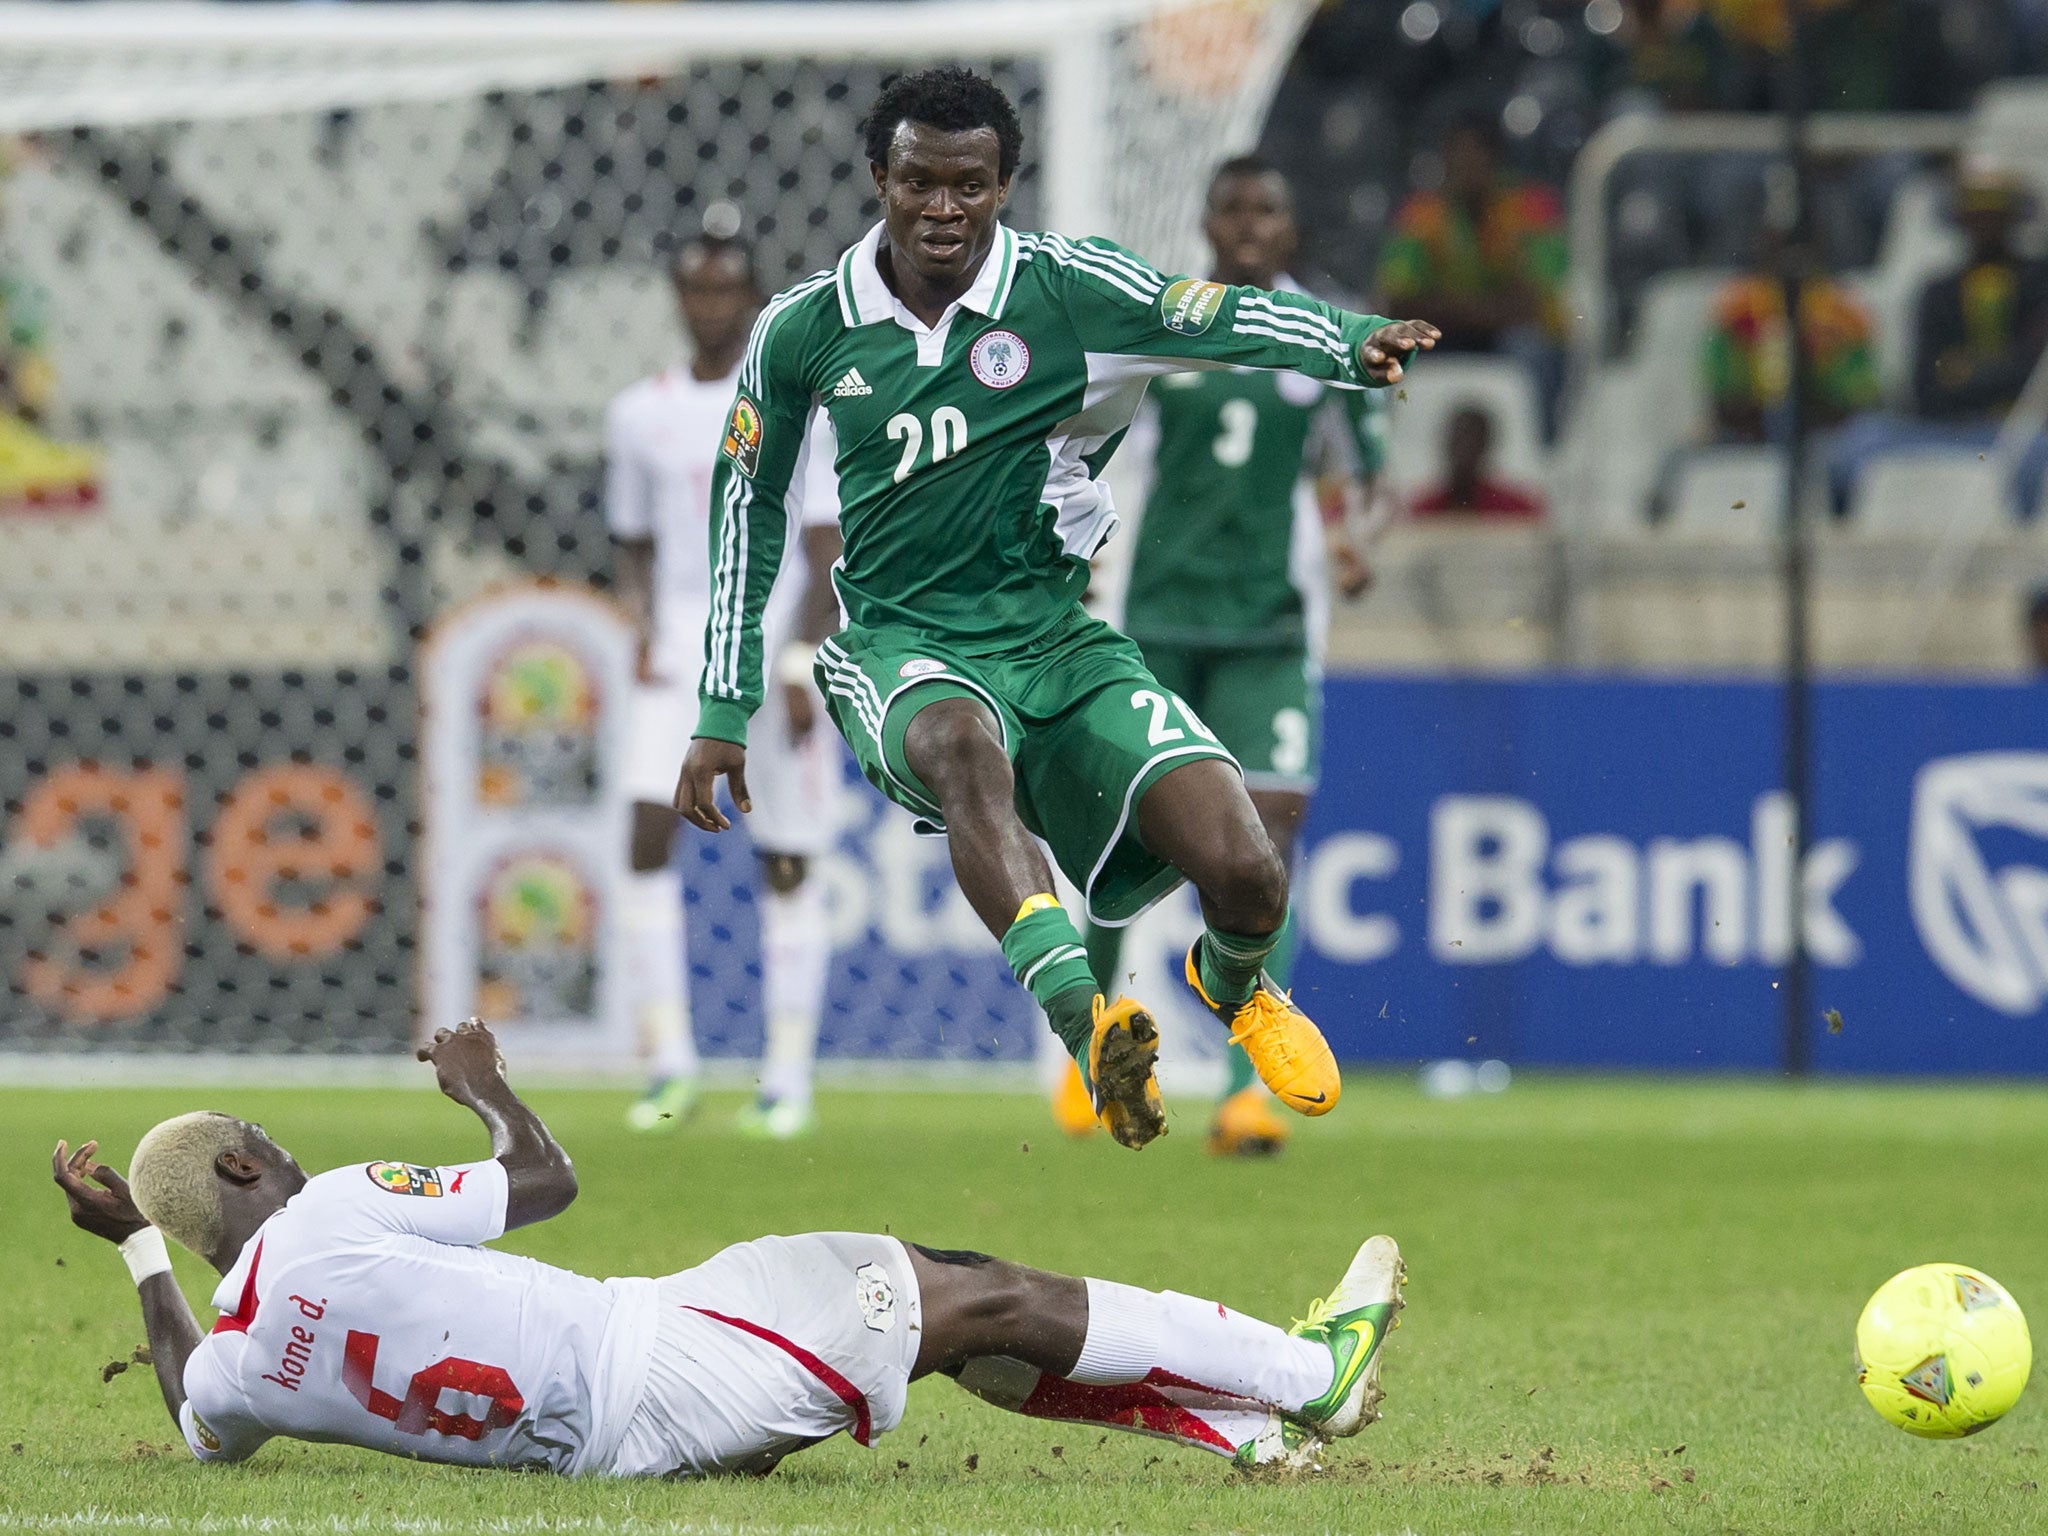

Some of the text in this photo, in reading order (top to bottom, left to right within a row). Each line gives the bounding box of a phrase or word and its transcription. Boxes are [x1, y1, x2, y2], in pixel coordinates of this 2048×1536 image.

[1190, 287, 1219, 326] AFRICA
[833, 385, 873, 396] adidas
[886, 406, 968, 484] 20
[1213, 398, 1258, 468] 3
[1271, 707, 1309, 773] 3
[1429, 791, 1863, 966] Bank
[261, 1294, 328, 1392] kone d.
[341, 1329, 525, 1441] 6
